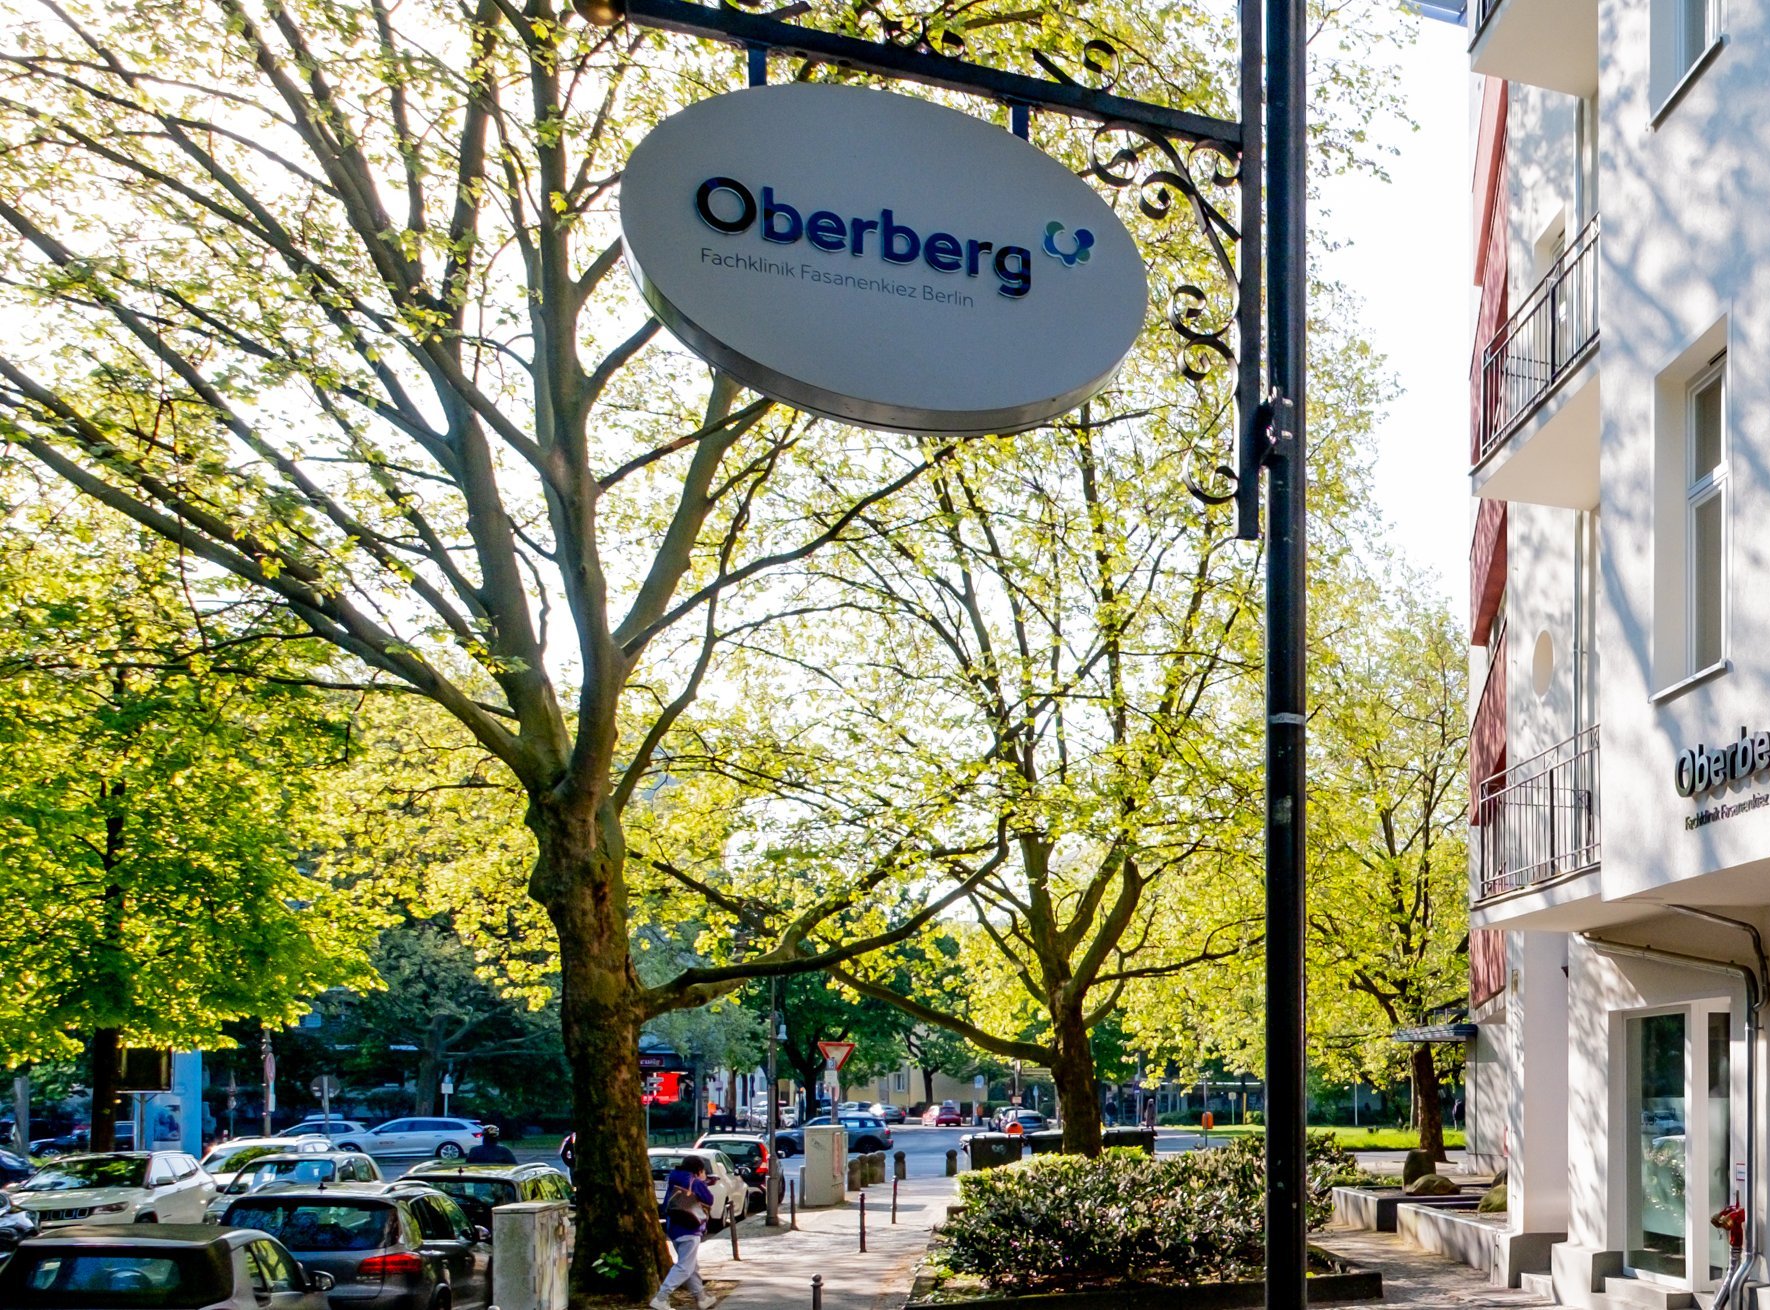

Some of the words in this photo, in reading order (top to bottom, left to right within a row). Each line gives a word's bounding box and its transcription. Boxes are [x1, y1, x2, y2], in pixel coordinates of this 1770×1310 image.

[696, 176, 1032, 299] Oberberg
[701, 247, 795, 278] Fachklinik
[801, 264, 917, 298] Fasanenkiez
[922, 284, 974, 308] Berlin
